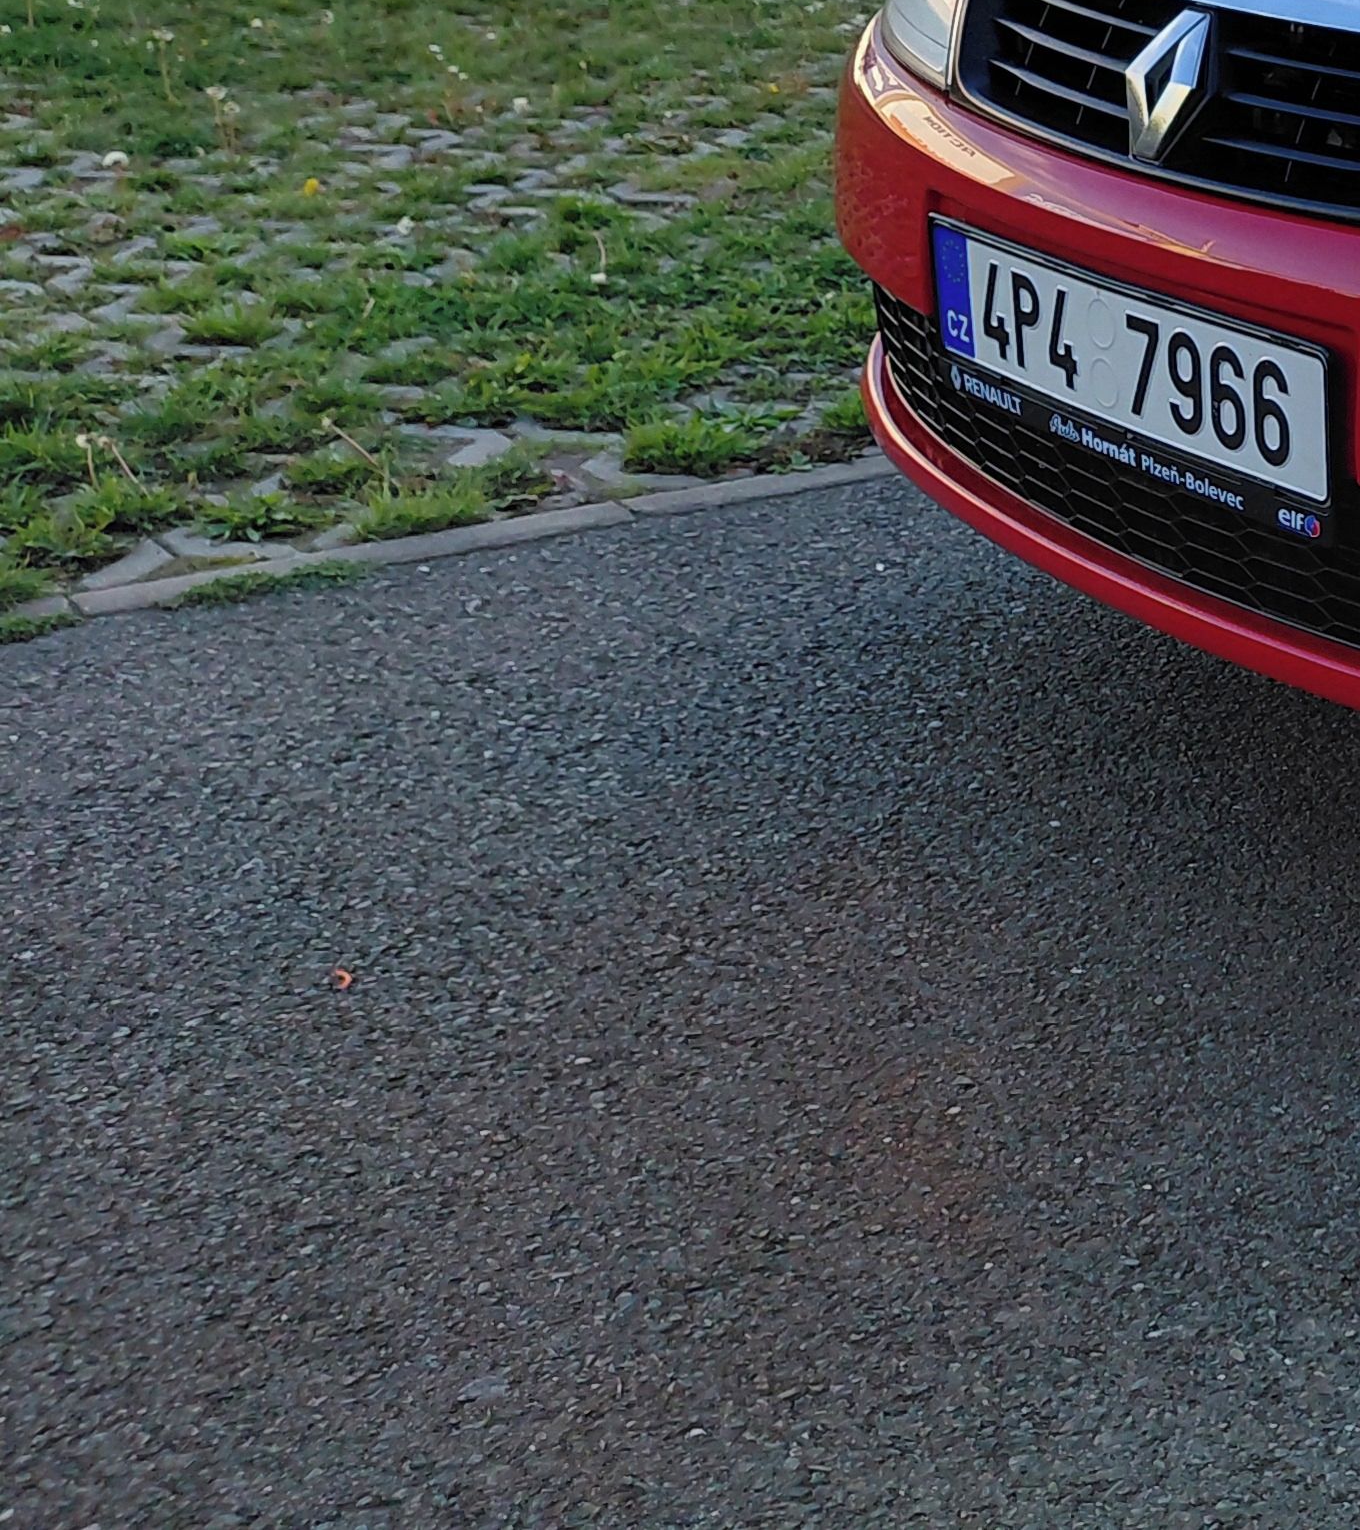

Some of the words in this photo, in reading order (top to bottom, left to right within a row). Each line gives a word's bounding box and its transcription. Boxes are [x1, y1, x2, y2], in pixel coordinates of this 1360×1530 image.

[947, 309, 970, 343] CZ
[983, 261, 1078, 391] 4P4
[1125, 313, 1290, 467] 7966
[963, 373, 1024, 416] RENAULT
[1081, 427, 1137, 468] Hornát
[1141, 453, 1246, 511] Plzeň-Bolevec
[1277, 507, 1305, 531] elf
